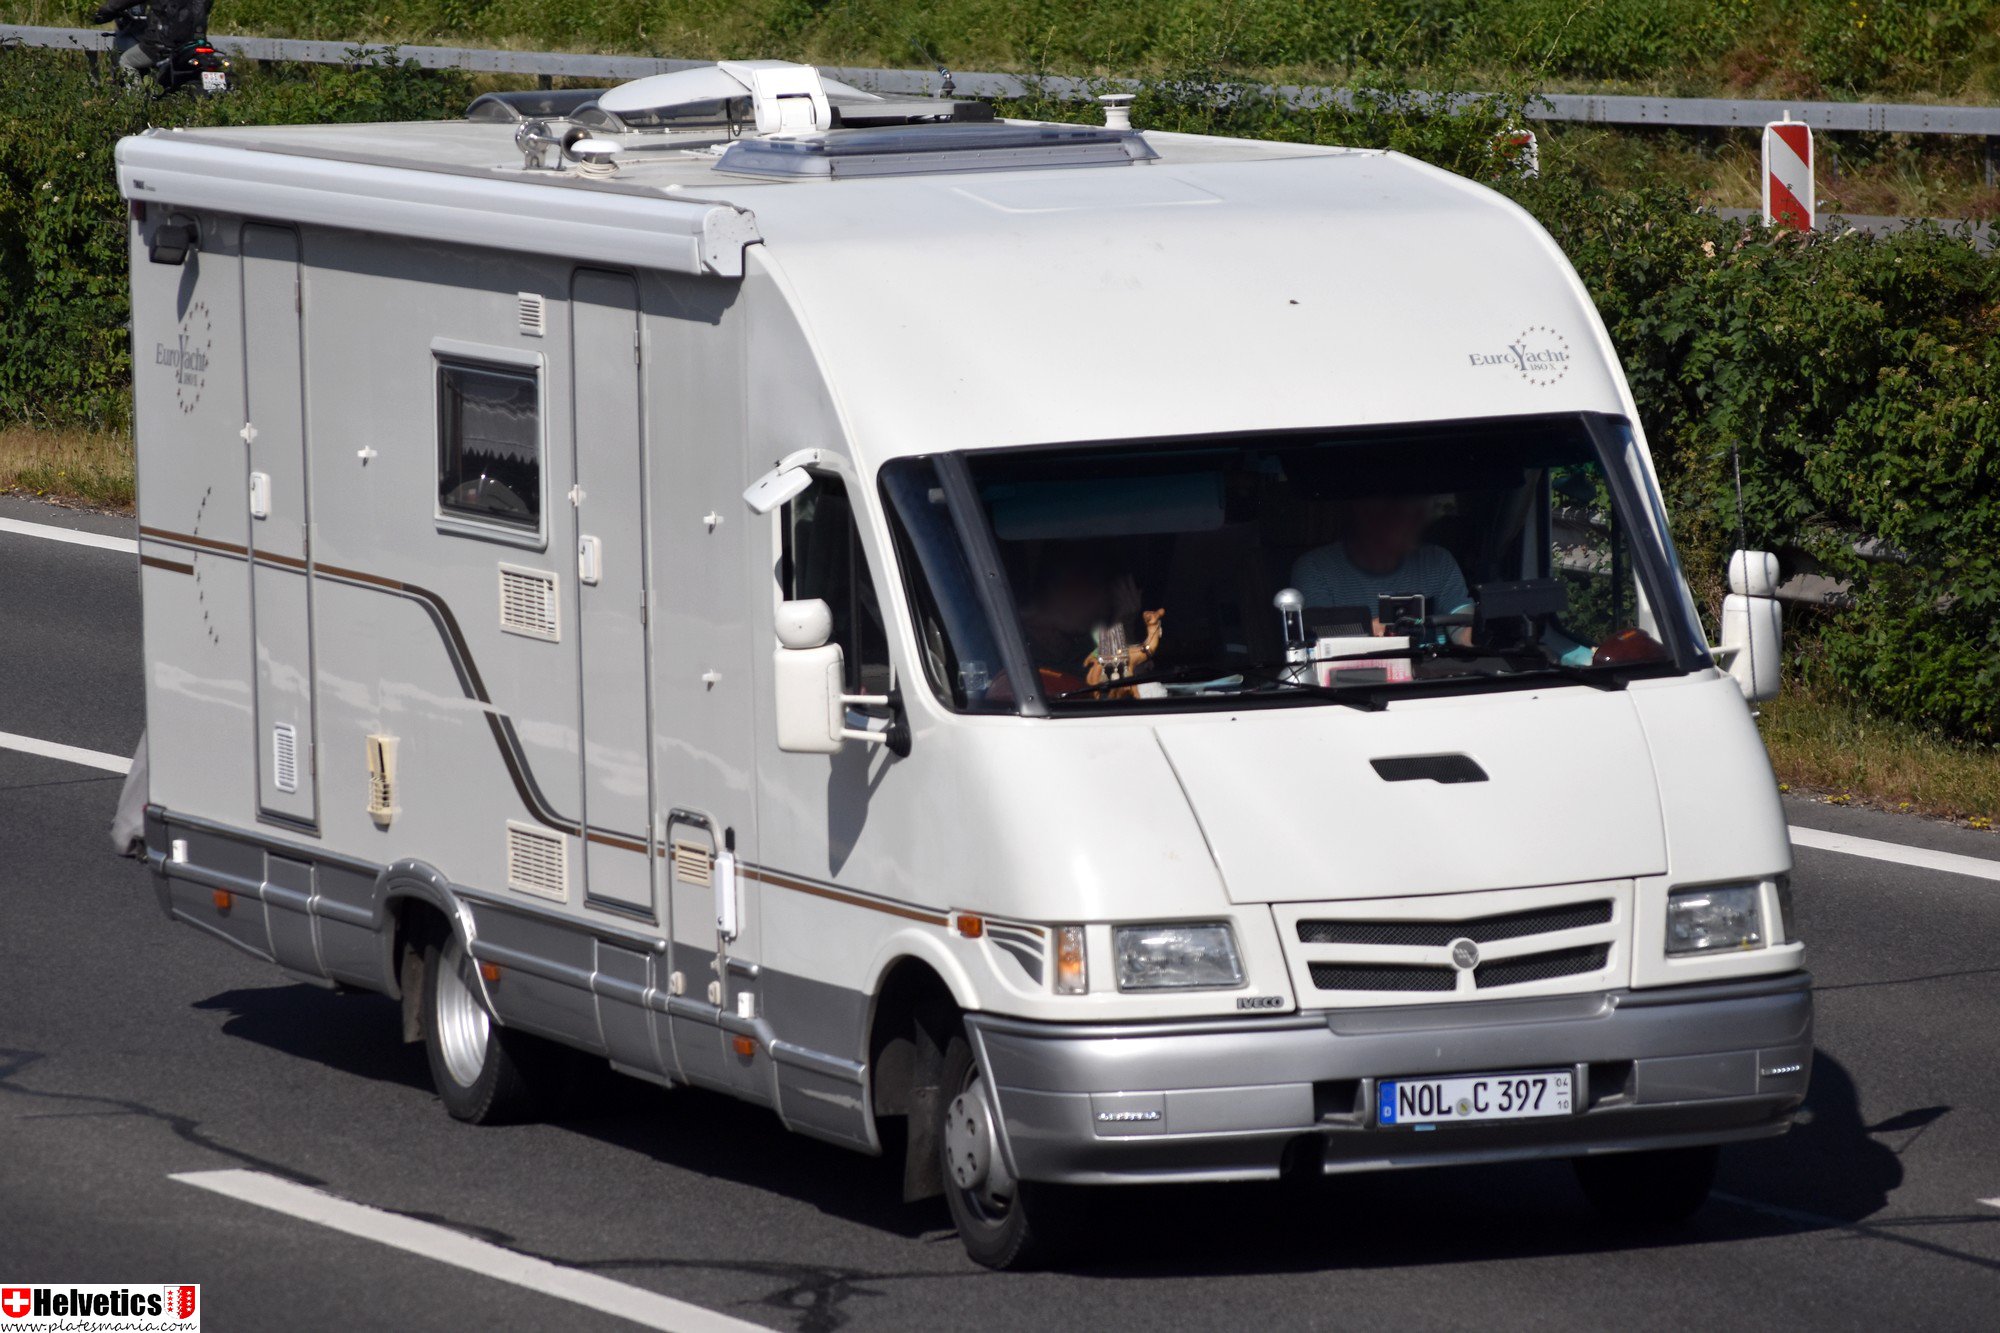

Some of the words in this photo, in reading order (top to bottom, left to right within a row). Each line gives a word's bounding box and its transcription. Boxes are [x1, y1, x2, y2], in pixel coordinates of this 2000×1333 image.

[1236, 996, 1285, 1010] IVECO
[1399, 1083, 1453, 1117] NOL
[1473, 1082, 1489, 1113] C
[1498, 1078, 1548, 1112] 397
